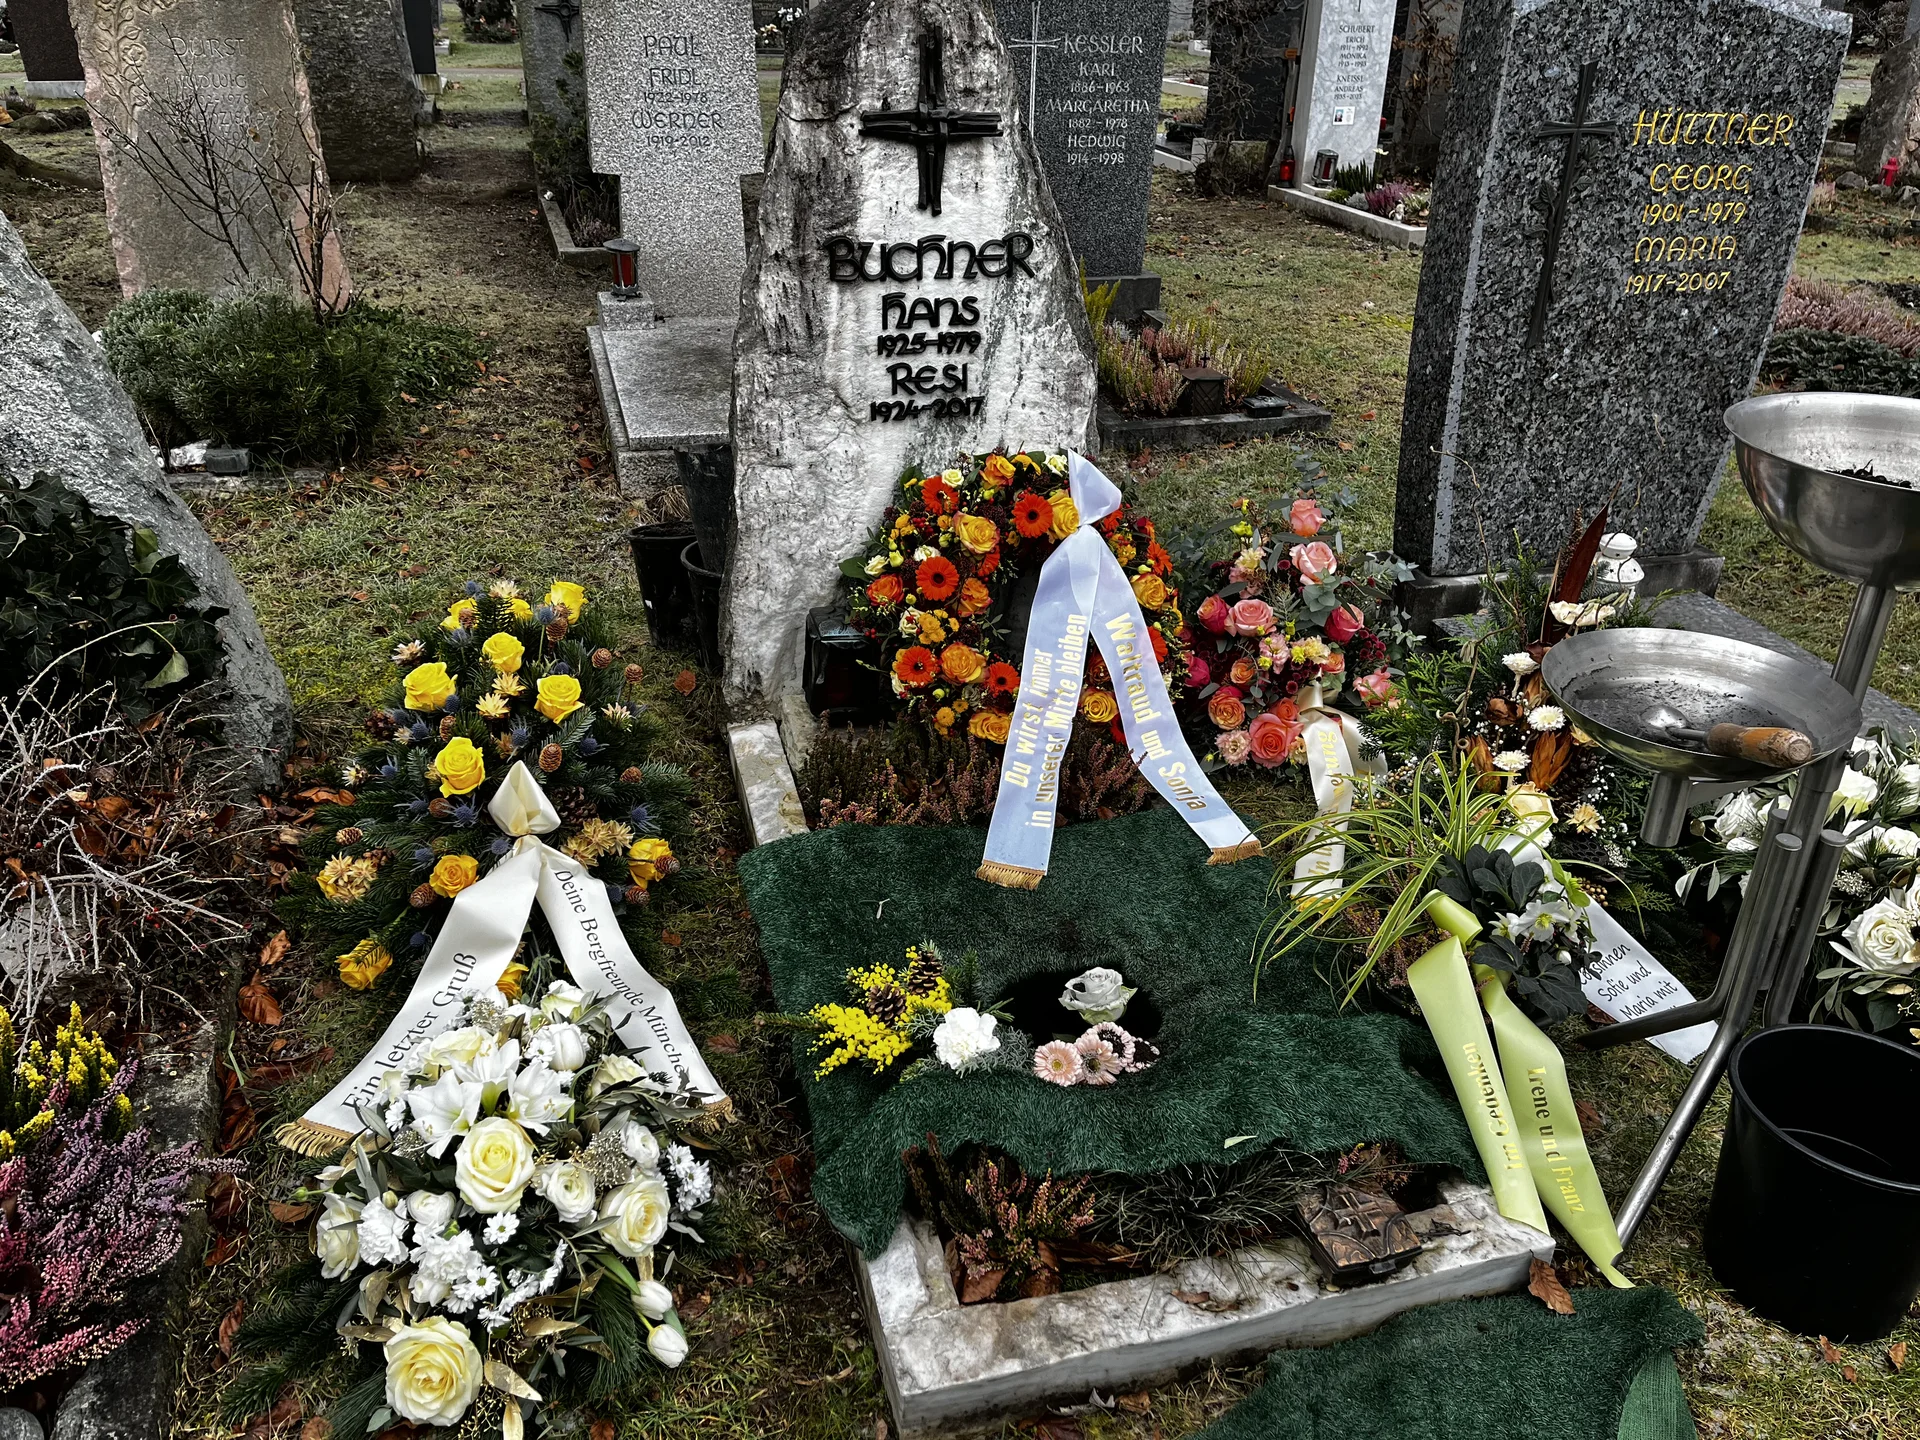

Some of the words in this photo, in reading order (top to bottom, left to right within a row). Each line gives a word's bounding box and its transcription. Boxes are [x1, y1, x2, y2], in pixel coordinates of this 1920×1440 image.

[643, 36, 702, 57] PAUL
[1063, 33, 1143, 54] KESSLER
[1338, 25, 1375, 33] SCHUBERT
[650, 67, 703, 87] FRIDL
[632, 108, 724, 129] WERNER
[1044, 98, 1151, 115] MARGARETHA
[647, 135, 711, 148] 1919-2012
[1067, 134, 1126, 149] HEDWIG
[1632, 106, 1795, 147] HÜTTNER
[1650, 163, 1753, 196] GEORG
[1634, 235, 1737, 264] MARIA
[877, 331, 981, 357] 1925-1979
[886, 362, 968, 396] RESI
[870, 396, 985, 423] 1924-2017
[1055, 614, 1088, 676] bleiben
[1023, 648, 1053, 698] immer
[1043, 678, 1079, 730] Mitte
[1105, 612, 1162, 724] Waltraud
[1140, 730, 1173, 761] und
[1158, 761, 1207, 811] Sonja
[1014, 701, 1044, 755] wirst
[1004, 760, 1033, 788] Du
[1035, 733, 1066, 803] unserer
[1025, 810, 1053, 828] in
[554, 870, 587, 914] Deine
[580, 917, 644, 1007] Bergfreunde
[639, 1005, 688, 1079] Münche
[1580, 944, 1631, 985] Cosinen
[1597, 978, 1629, 1002] Sofie
[1626, 960, 1652, 984] und
[374, 1011, 440, 1069] letzter
[432, 952, 478, 1007] Gruß
[1619, 995, 1658, 1020] Maria
[1653, 980, 1678, 1000] mit
[1462, 1042, 1510, 1137] Gedenken
[1527, 1066, 1550, 1119] Irene
[1502, 1142, 1524, 1170] Im
[1539, 1124, 1568, 1162] und
[1551, 1165, 1585, 1214] Franz
